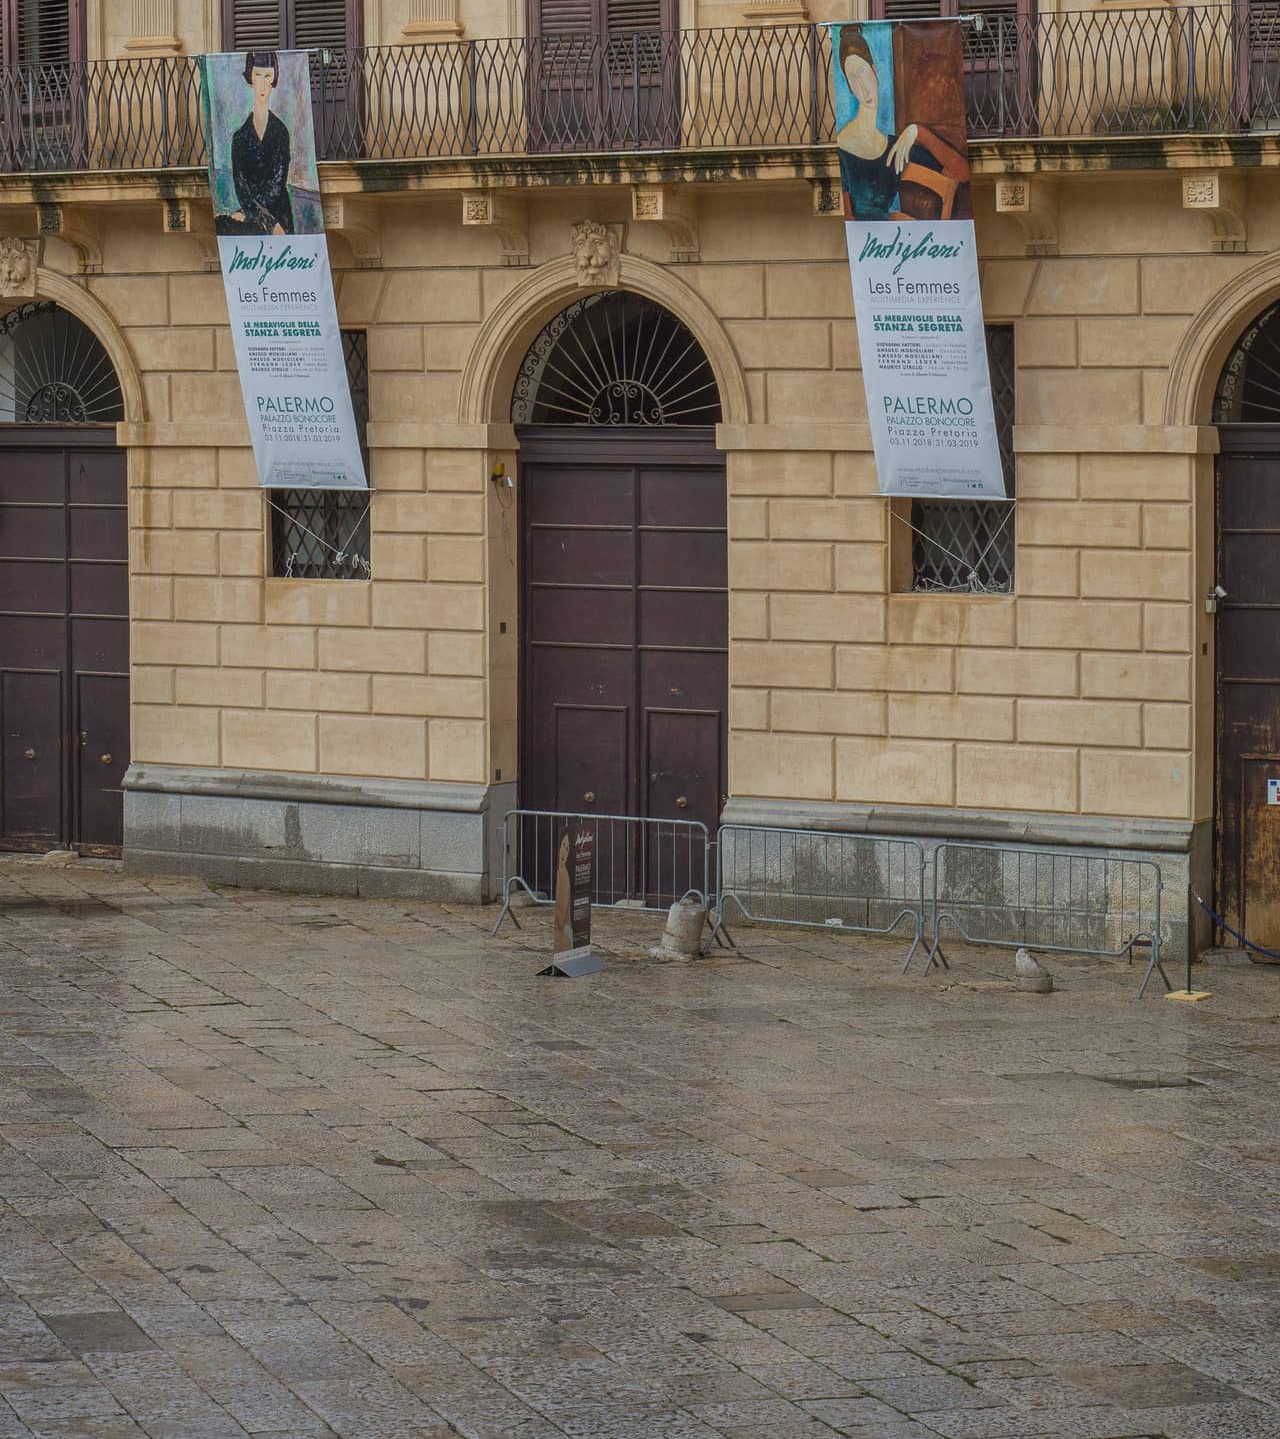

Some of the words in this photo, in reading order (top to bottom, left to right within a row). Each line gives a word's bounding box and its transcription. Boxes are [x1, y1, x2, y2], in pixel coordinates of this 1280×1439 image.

[858, 226, 964, 275] Modigliani
[228, 241, 318, 285] Modigliani
[869, 277, 891, 294] Les
[897, 277, 960, 294] Femmes
[238, 287, 258, 302] Les
[262, 287, 317, 302] Femmes
[245, 329, 279, 337] STANZA
[283, 328, 322, 337] SEGRETA
[873, 323, 914, 331] STANZA
[918, 323, 964, 332] SEGRETA
[256, 396, 334, 413] PALERMO
[883, 396, 973, 415] PALERMO
[260, 415, 292, 423] PALAZZO
[294, 415, 337, 423] BONOCORE
[886, 416, 923, 426] PALAZZO
[925, 417, 976, 427] BONOCORE
[262, 423, 294, 433] Piazza
[299, 424, 340, 433] Pretoria
[888, 426, 925, 436] Piazza
[931, 427, 978, 437] Pretoria
